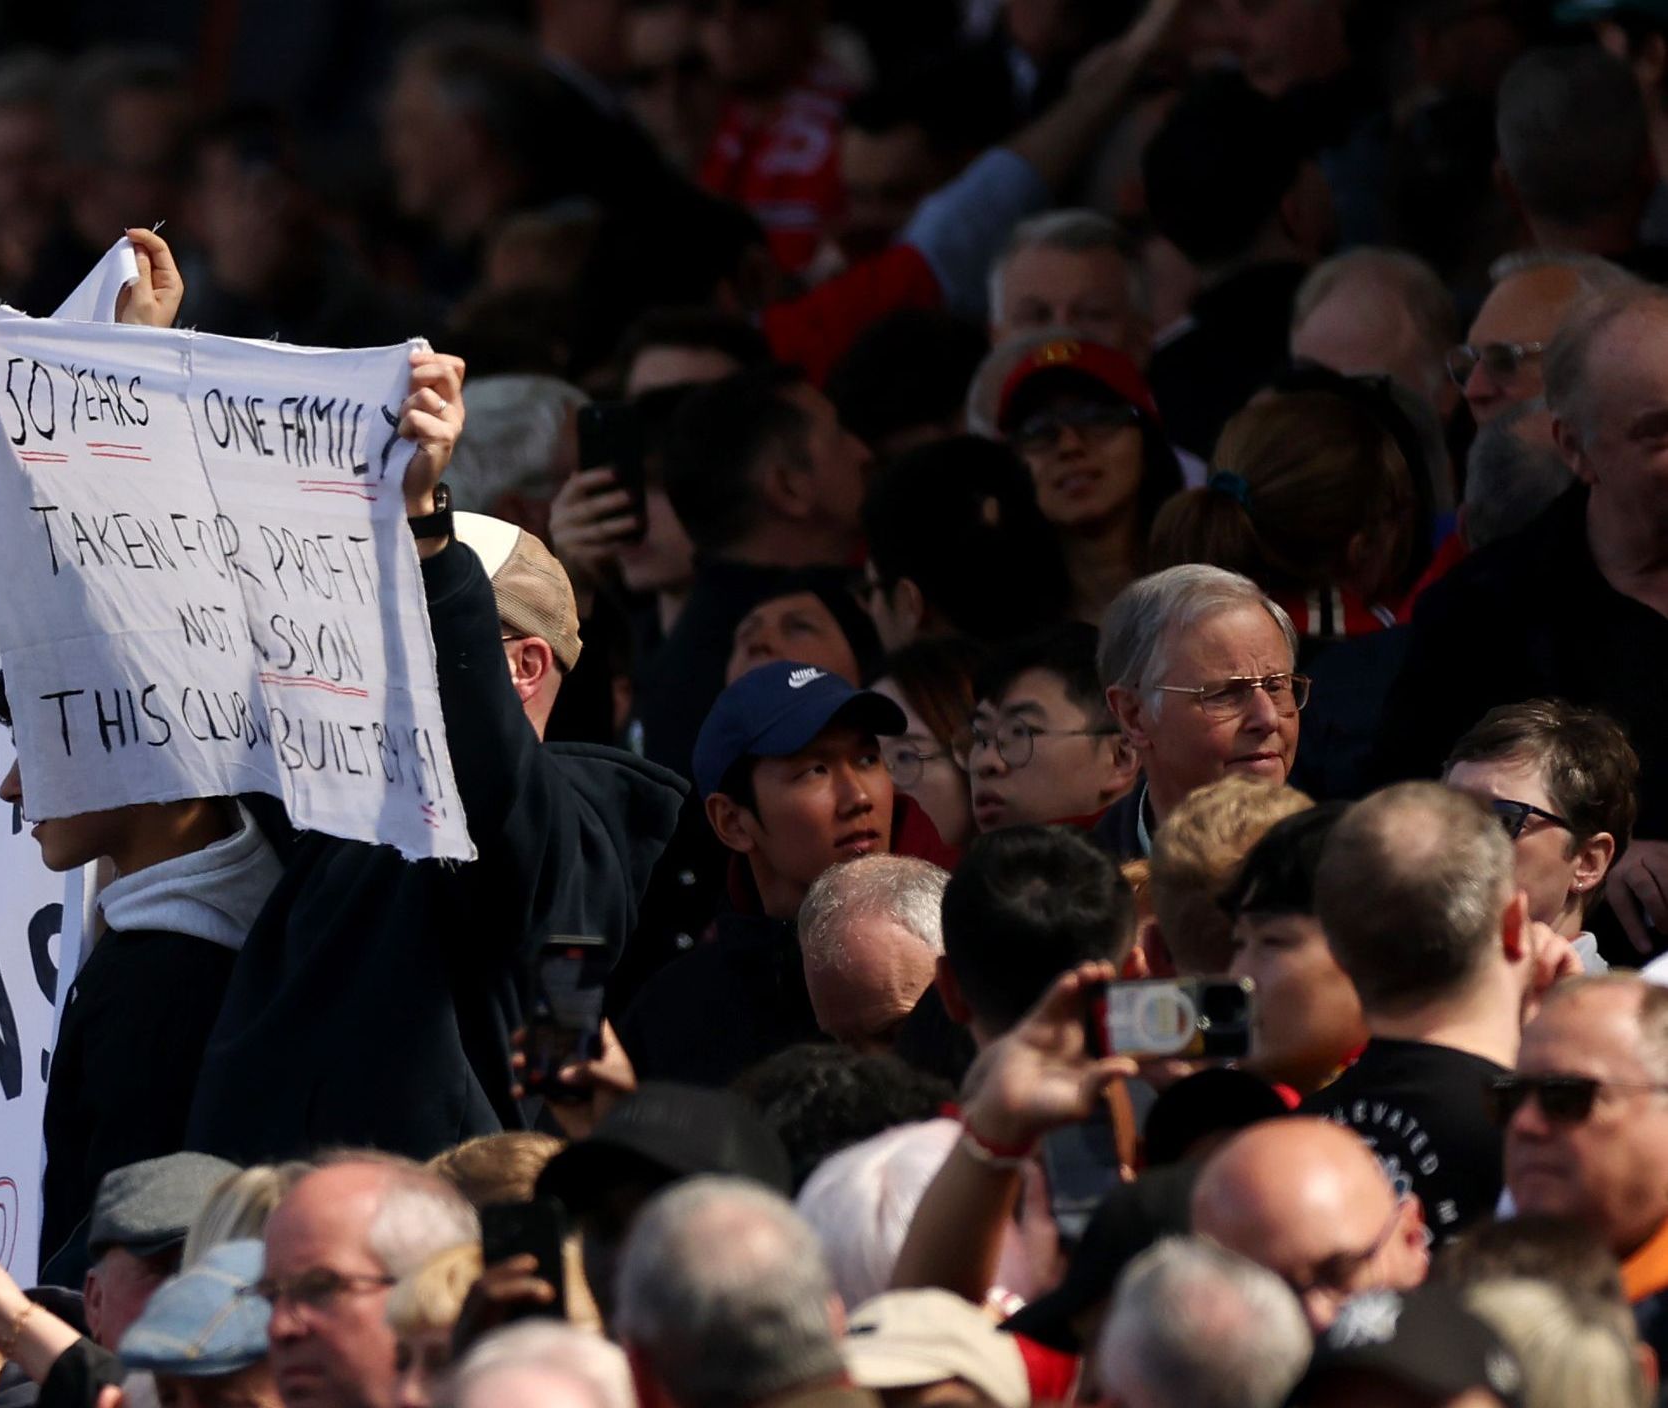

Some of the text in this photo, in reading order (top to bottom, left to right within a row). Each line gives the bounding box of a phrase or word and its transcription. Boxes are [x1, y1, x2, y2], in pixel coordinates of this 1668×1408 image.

[6, 358, 405, 479] 50 YEARS ONE FAMILY
[29, 506, 377, 604] TAKEN FOR PROFIT
[177, 603, 236, 657] NOT
[791, 667, 818, 681] NIKE
[40, 684, 171, 756] THIS
[182, 687, 257, 749] CLUB
[270, 708, 371, 776] BUILT
[1318, 1098, 1439, 1176] LEVATED
